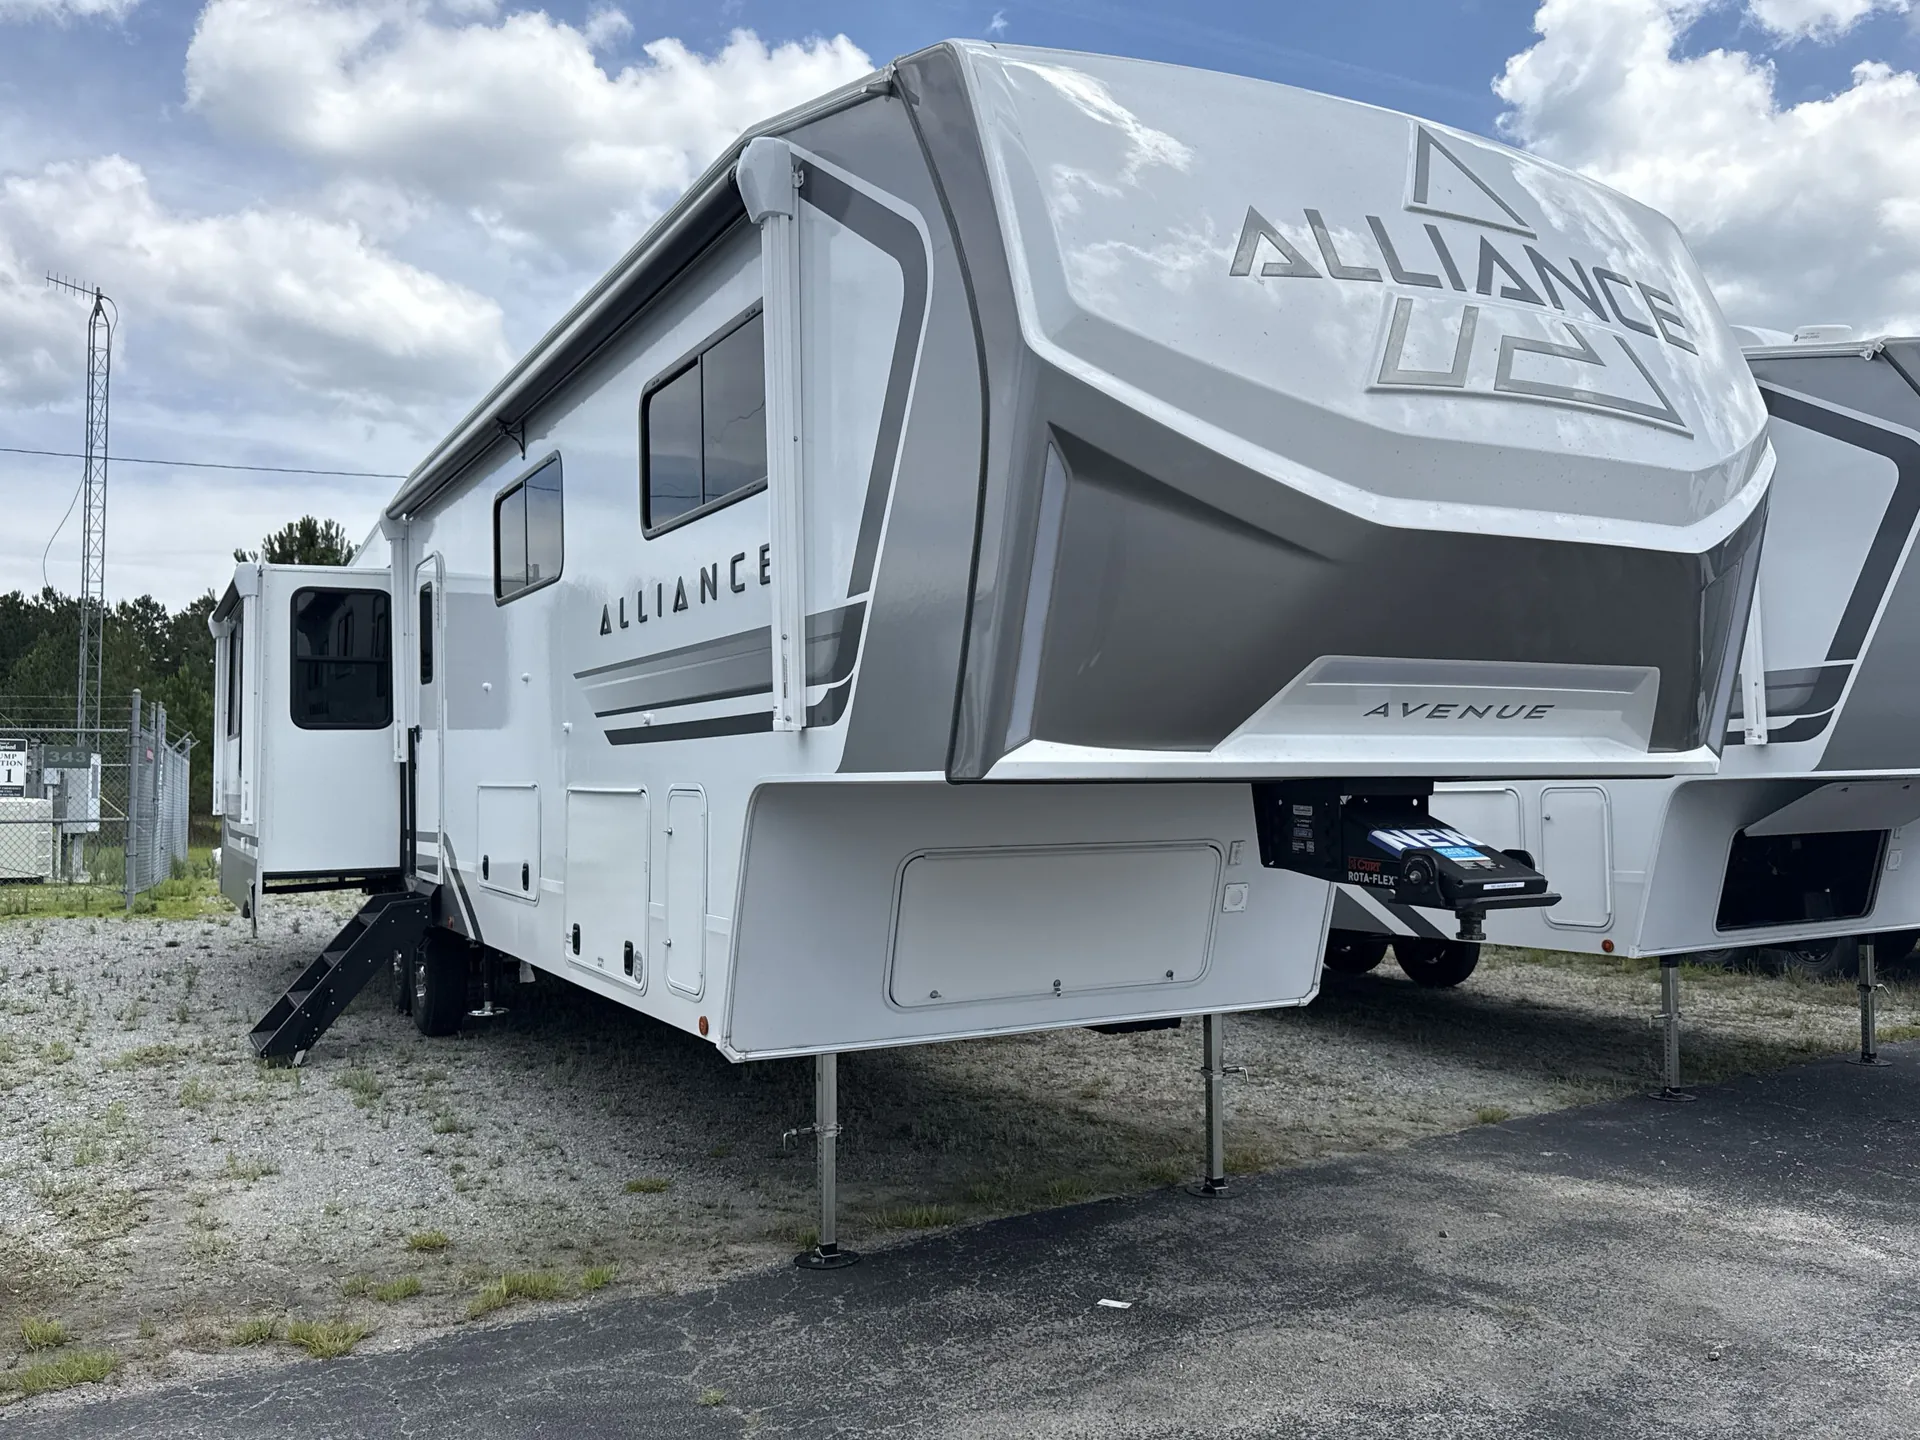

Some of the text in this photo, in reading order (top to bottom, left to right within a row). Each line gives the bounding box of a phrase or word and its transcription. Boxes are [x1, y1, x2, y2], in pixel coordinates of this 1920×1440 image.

[1229, 204, 1699, 356] ALLIANCE
[599, 542, 770, 636] ALLIANCE
[1362, 702, 1555, 720] AVENUE
[48, 751, 87, 763] 343
[5, 769, 13, 783] 1
[1371, 828, 1486, 852] NEW
[1356, 859, 1381, 872] CURT
